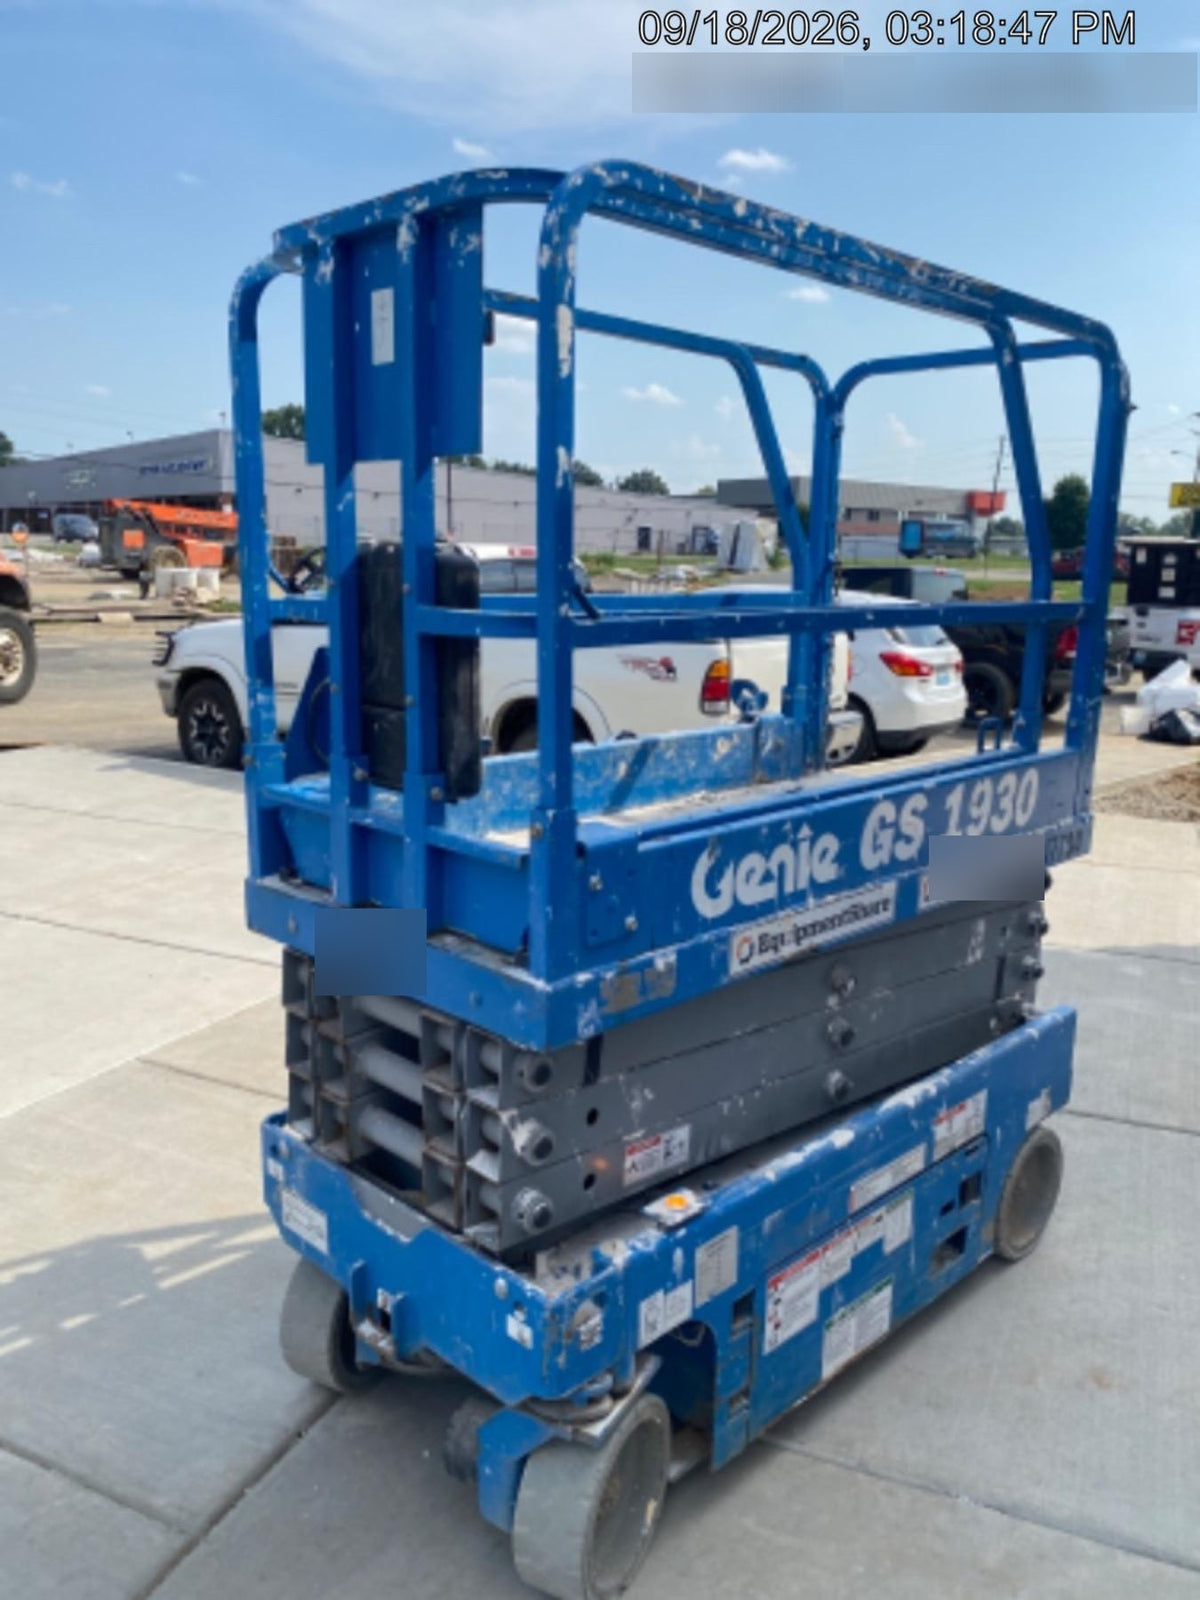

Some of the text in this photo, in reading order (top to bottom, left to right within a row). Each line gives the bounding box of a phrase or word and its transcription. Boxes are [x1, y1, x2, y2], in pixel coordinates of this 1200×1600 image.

[691, 769, 1038, 919] Genie GS 1930
